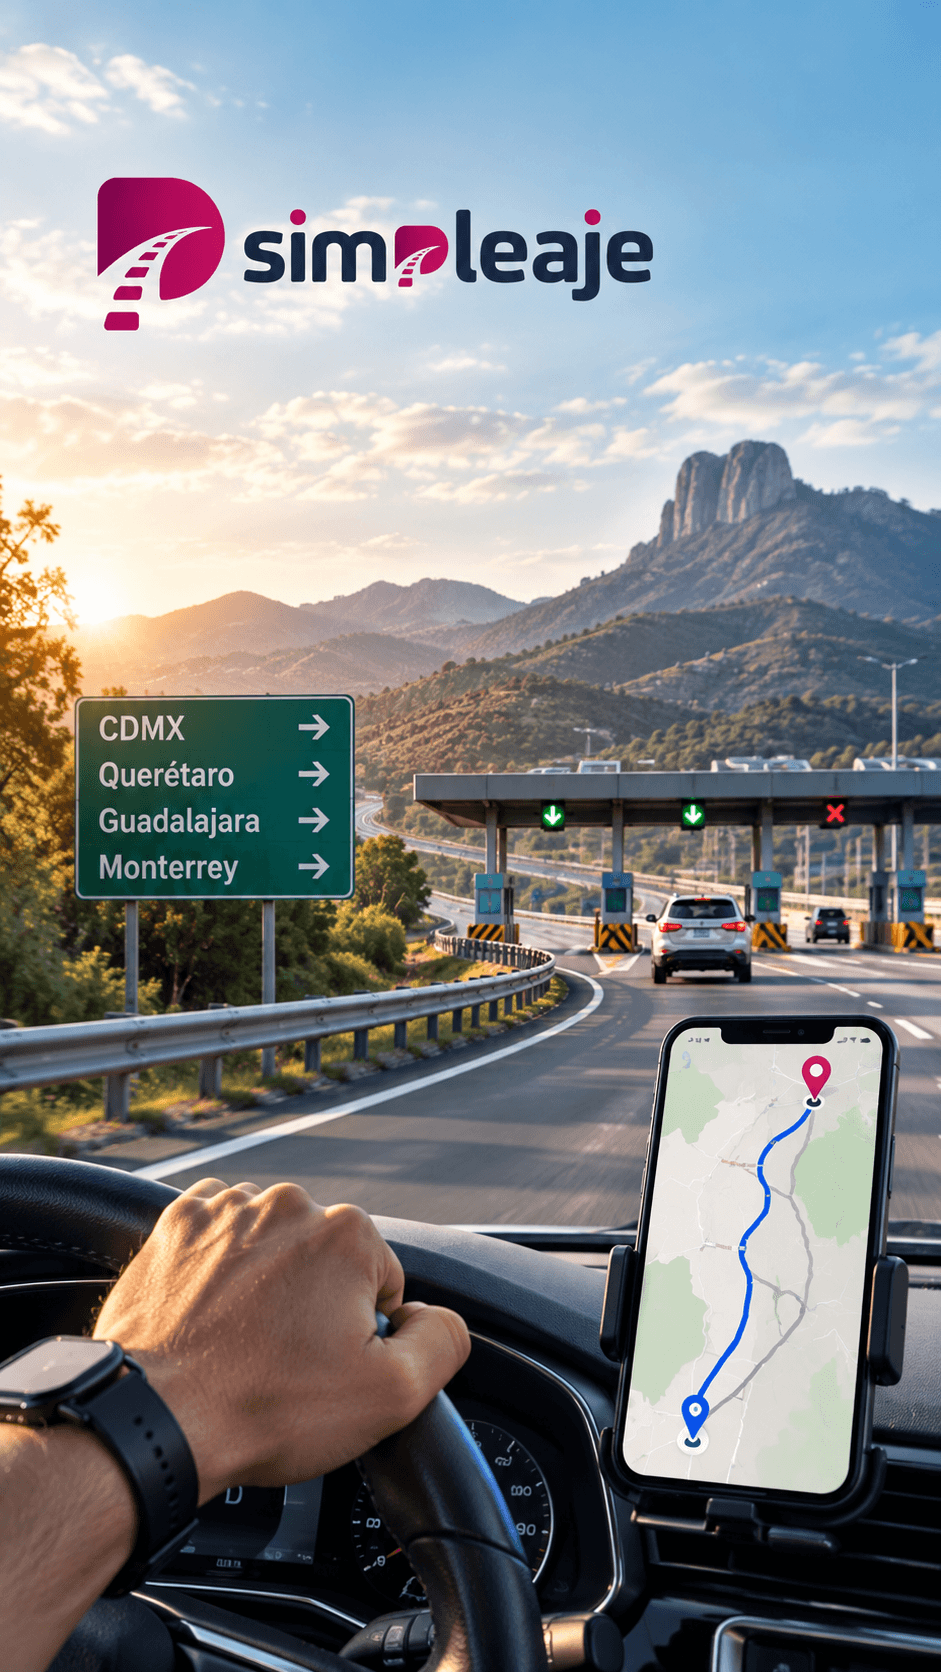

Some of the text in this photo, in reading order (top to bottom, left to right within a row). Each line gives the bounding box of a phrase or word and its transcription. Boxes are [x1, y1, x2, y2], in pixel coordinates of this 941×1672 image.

[99, 714, 185, 742] CDMX
[98, 760, 235, 790] Querétaro
[98, 807, 261, 839] Guadalajara
[99, 853, 239, 885] Monterrey
